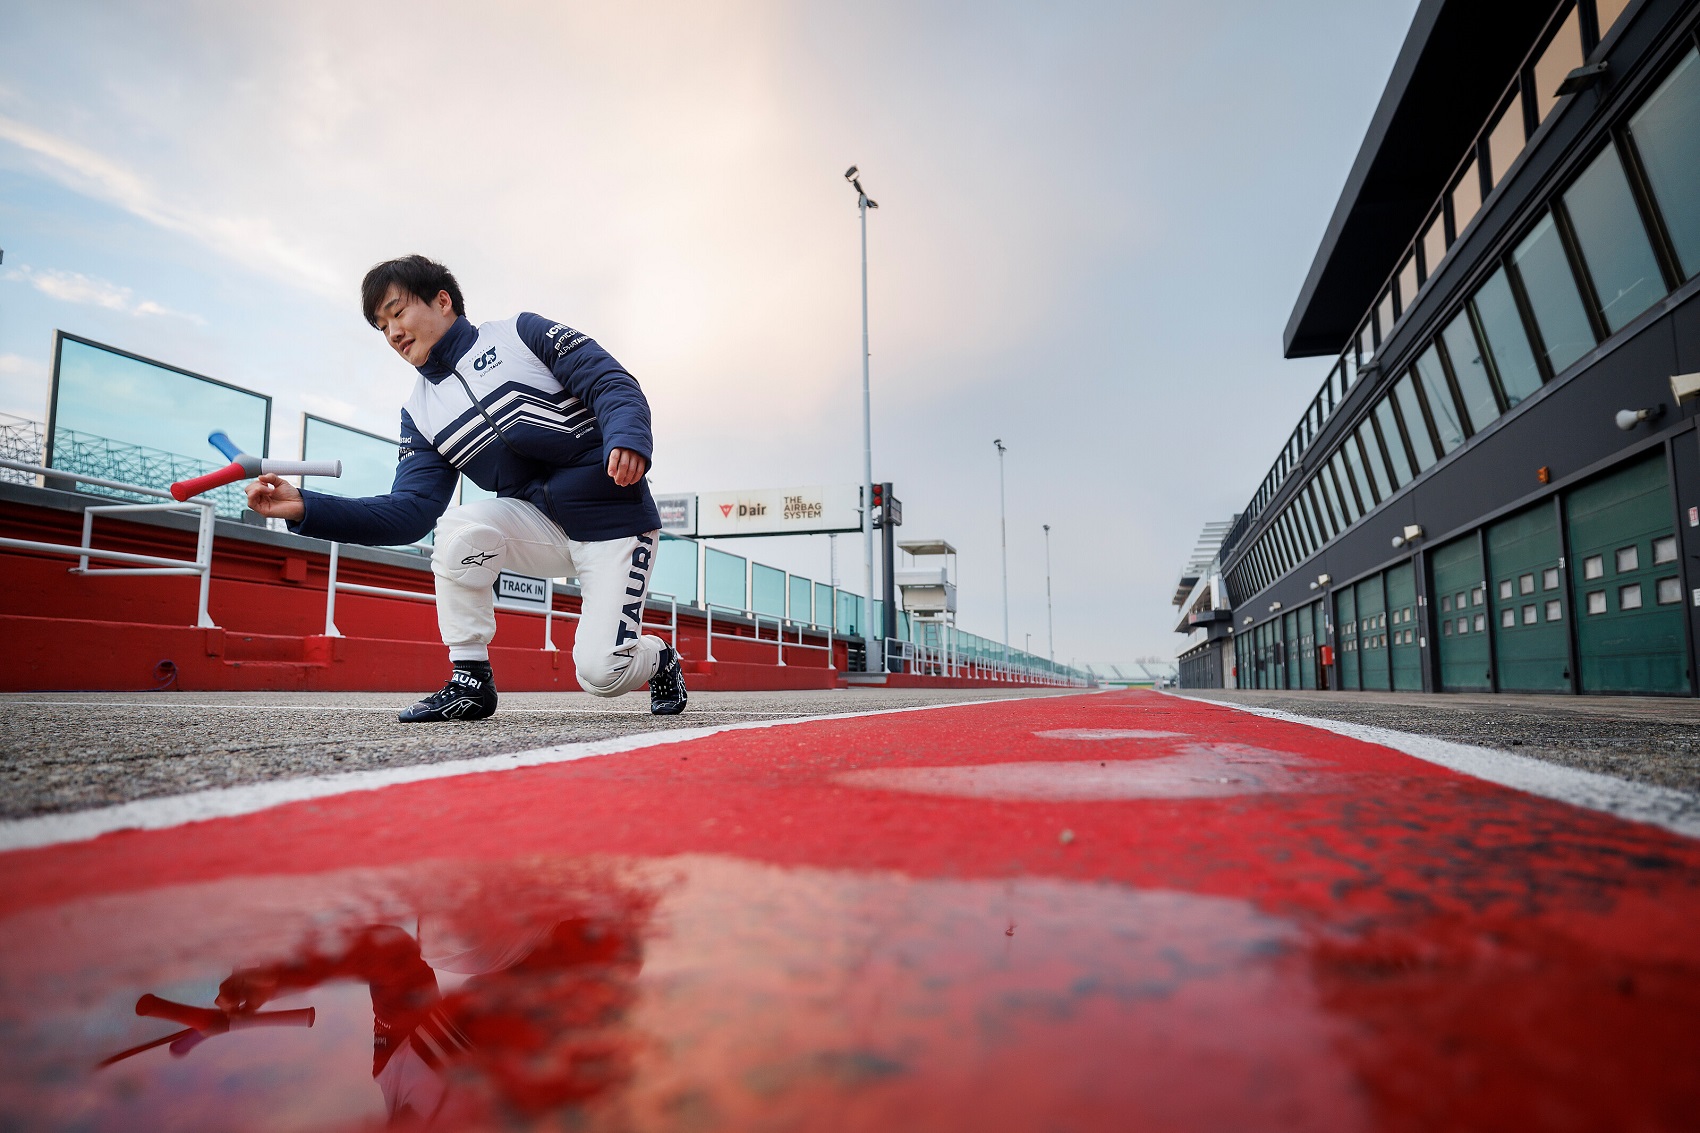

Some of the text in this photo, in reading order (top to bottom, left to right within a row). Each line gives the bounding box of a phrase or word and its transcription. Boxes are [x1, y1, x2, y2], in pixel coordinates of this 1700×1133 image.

[783, 496, 803, 504] THE
[783, 502, 822, 512] AIRBAG
[783, 510, 822, 520] SYSTEM
[502, 580, 544, 596] TRACK IN
